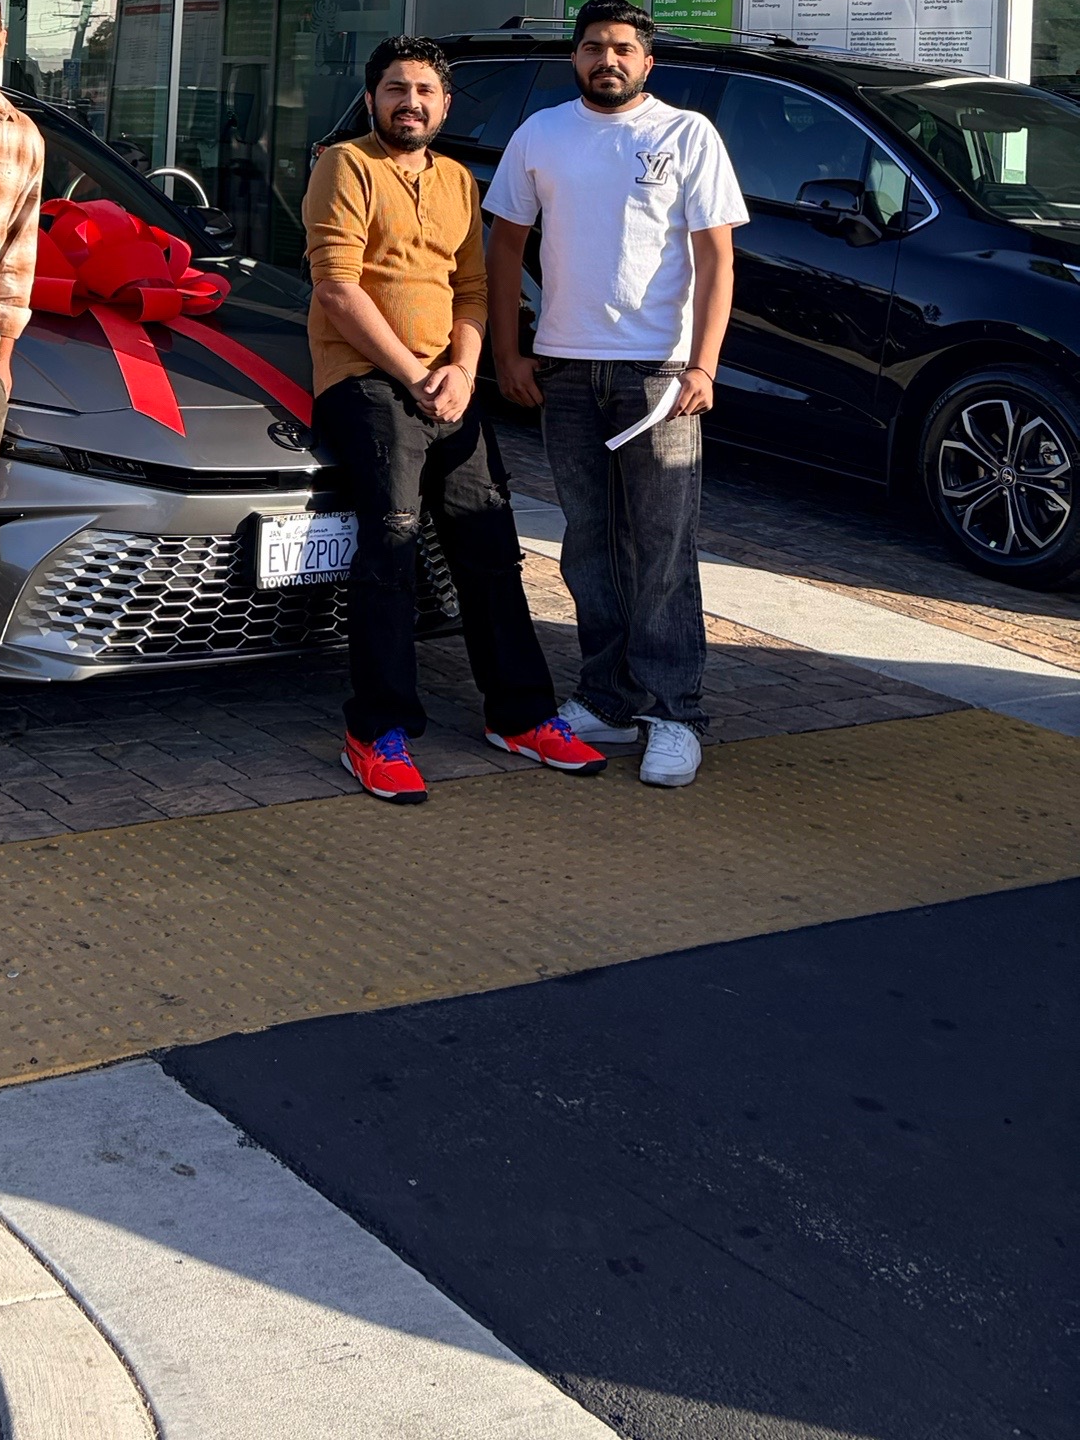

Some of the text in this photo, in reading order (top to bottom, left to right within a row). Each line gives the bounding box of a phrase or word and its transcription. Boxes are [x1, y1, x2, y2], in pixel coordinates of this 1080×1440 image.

[568, 7, 580, 17] Be
[702, 9, 717, 17] miles
[268, 537, 352, 573] EV72P02
[261, 571, 351, 589] TOYOTA SUNNYVA
